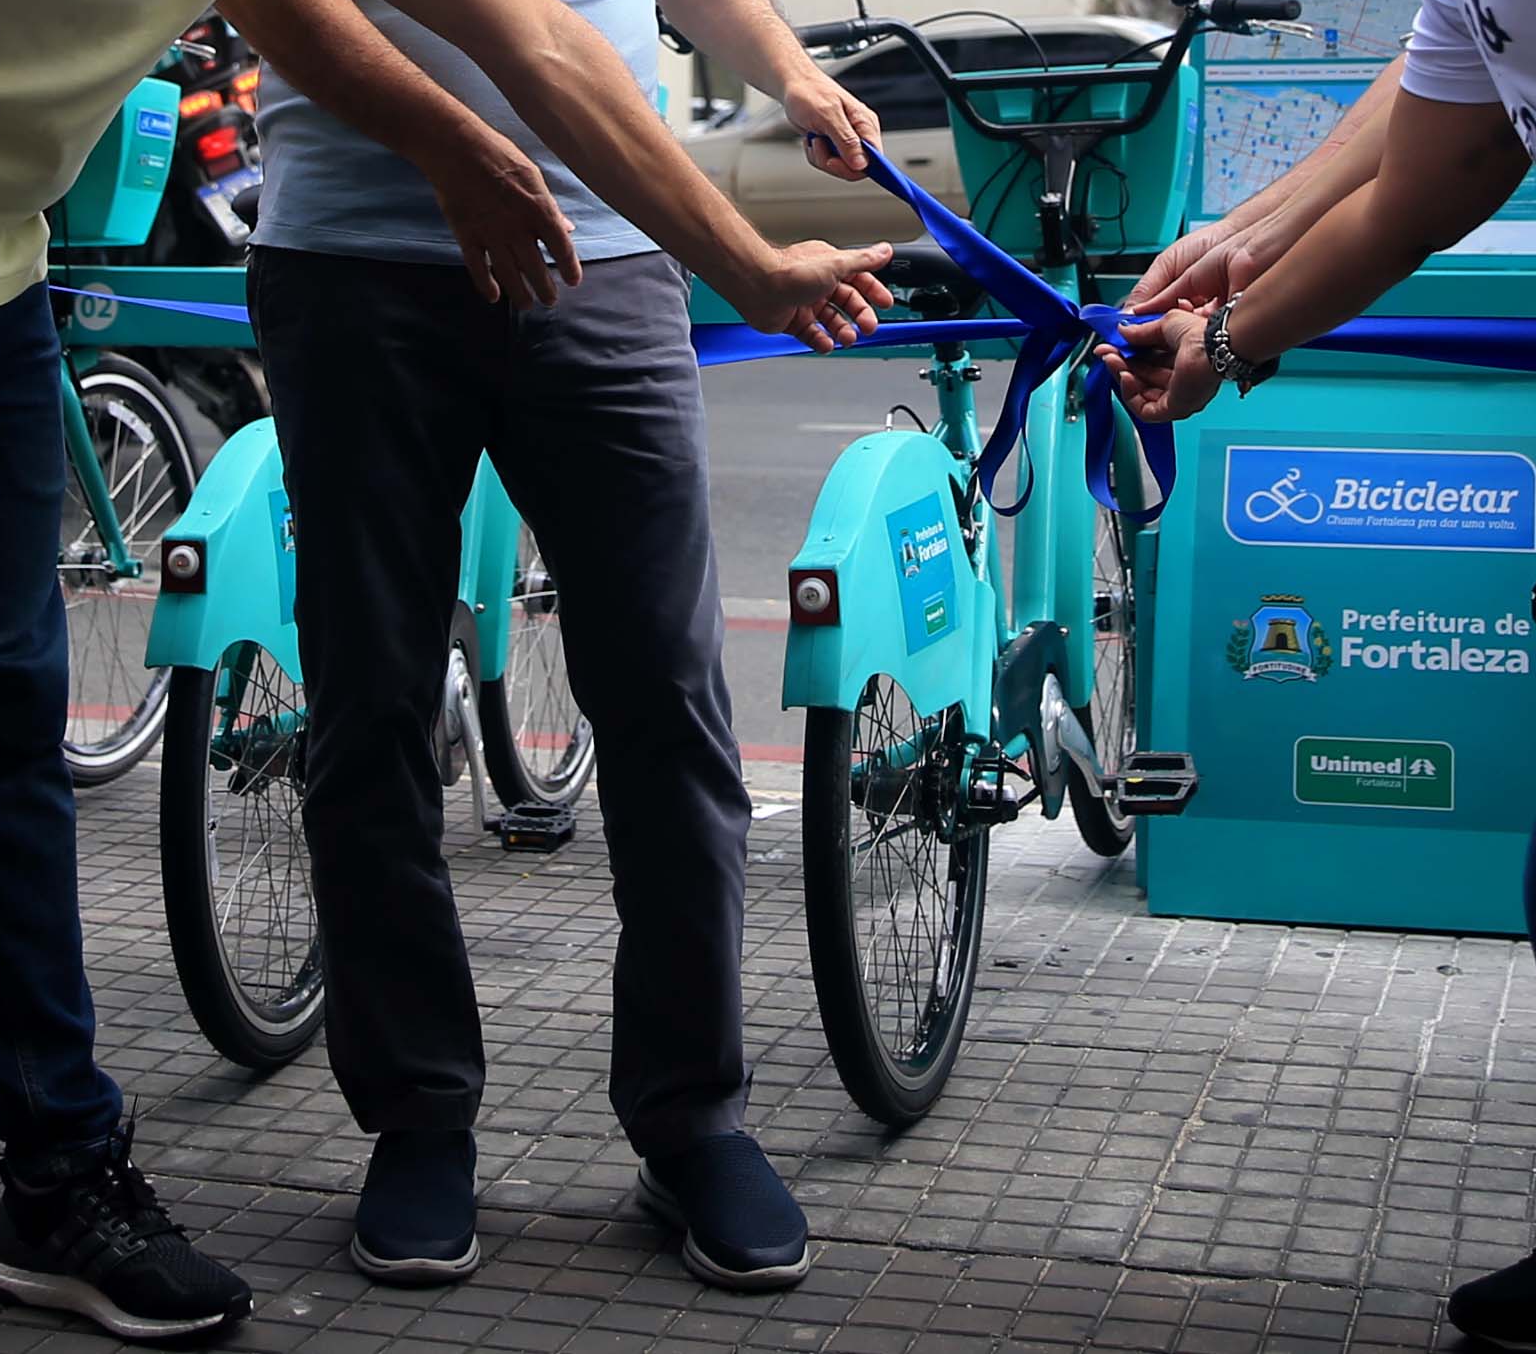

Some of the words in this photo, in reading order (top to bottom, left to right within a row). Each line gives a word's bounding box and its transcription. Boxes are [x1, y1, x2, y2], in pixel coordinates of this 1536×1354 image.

[80, 295, 112, 319] 02
[1329, 478, 1519, 514] Bicicletar
[1326, 514, 1364, 526] Chame
[1366, 515, 1415, 527] Fortaleza
[1417, 519, 1437, 529] pra
[1439, 518, 1459, 528] dar
[1461, 520, 1485, 529] uma
[1342, 608, 1486, 635] Prefeitura
[1494, 613, 1531, 636] de
[1340, 637, 1530, 674] Fortaleza
[1310, 755, 1402, 774] Unimed
[1355, 776, 1402, 788] Fortaleza
